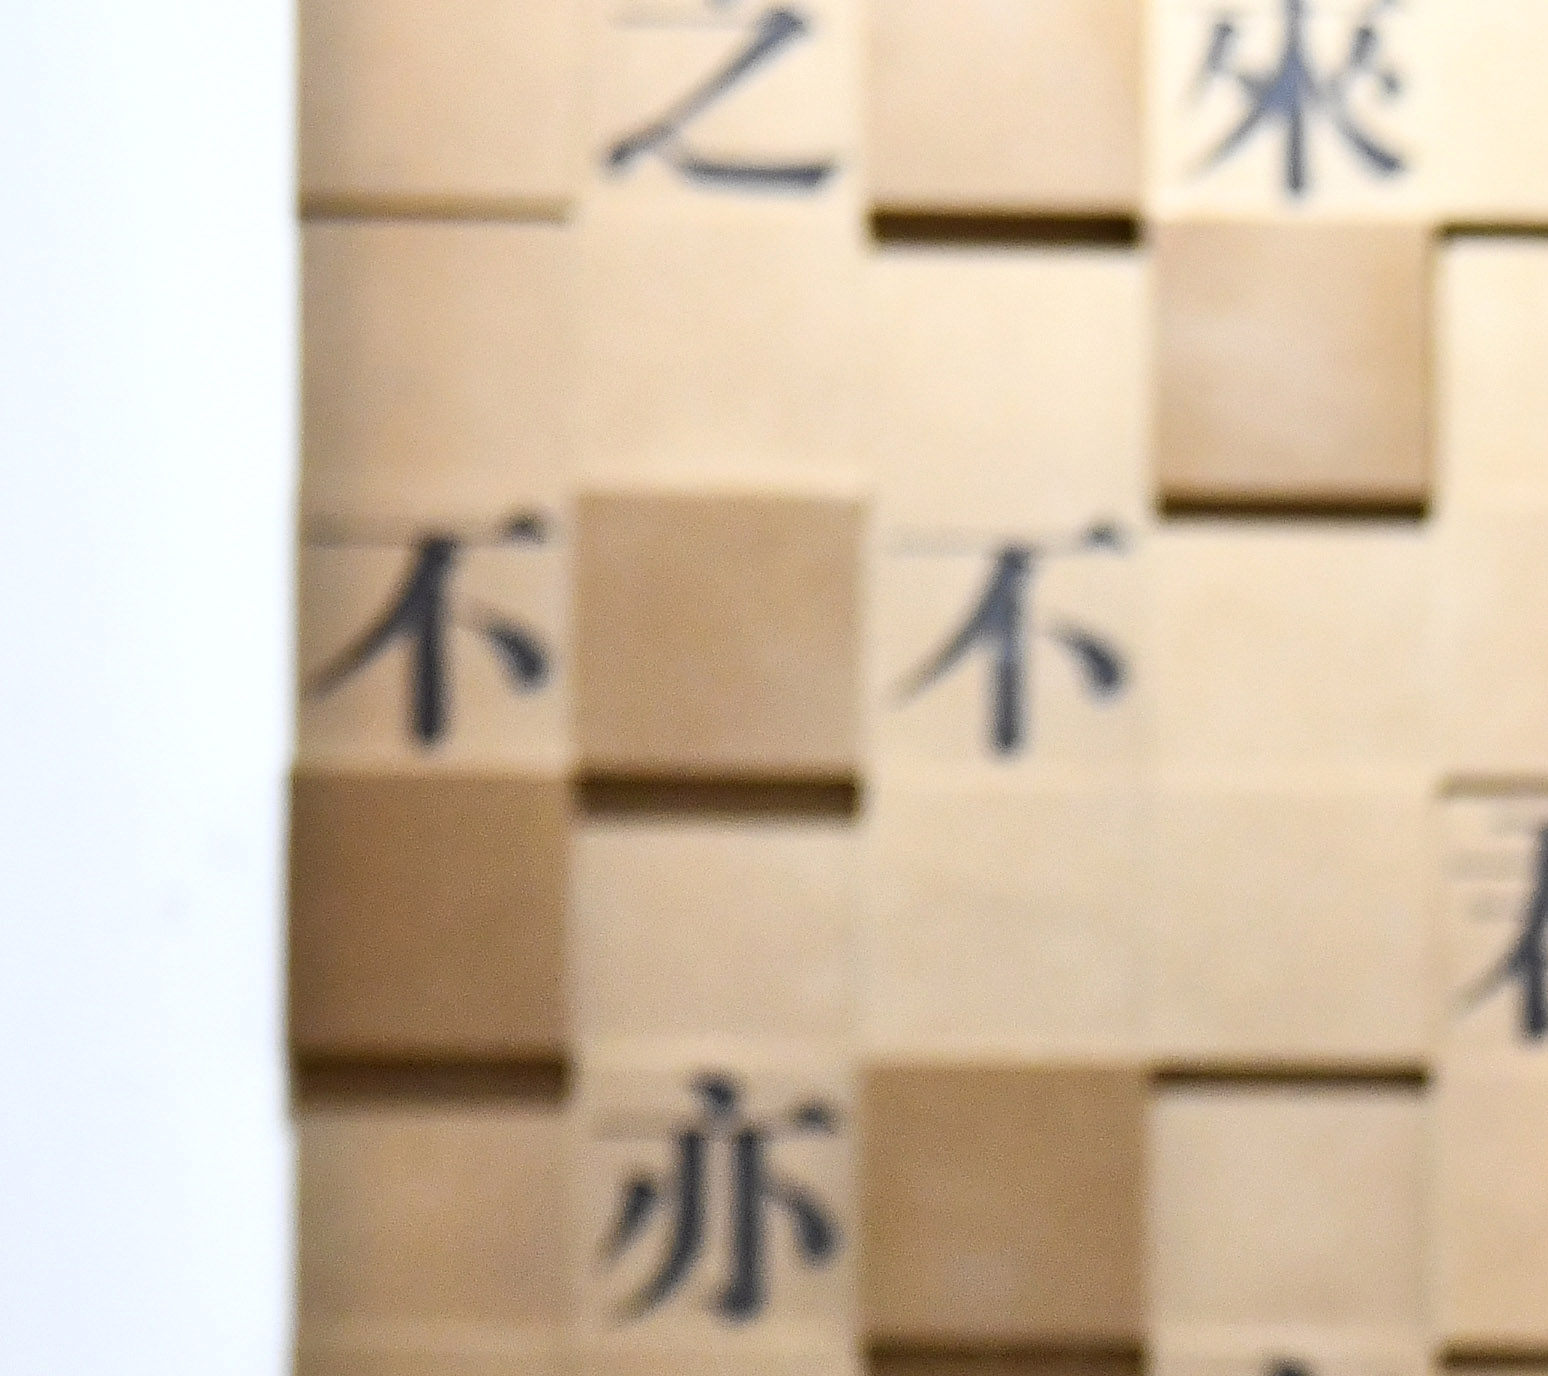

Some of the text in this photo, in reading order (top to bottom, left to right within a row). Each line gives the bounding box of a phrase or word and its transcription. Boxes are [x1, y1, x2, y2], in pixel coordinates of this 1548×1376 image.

[602, 0, 836, 192] 之
[1192, 0, 1416, 200] 來
[306, 515, 554, 750] 不
[890, 521, 1131, 758] 不
[599, 1072, 840, 1325] 亦
